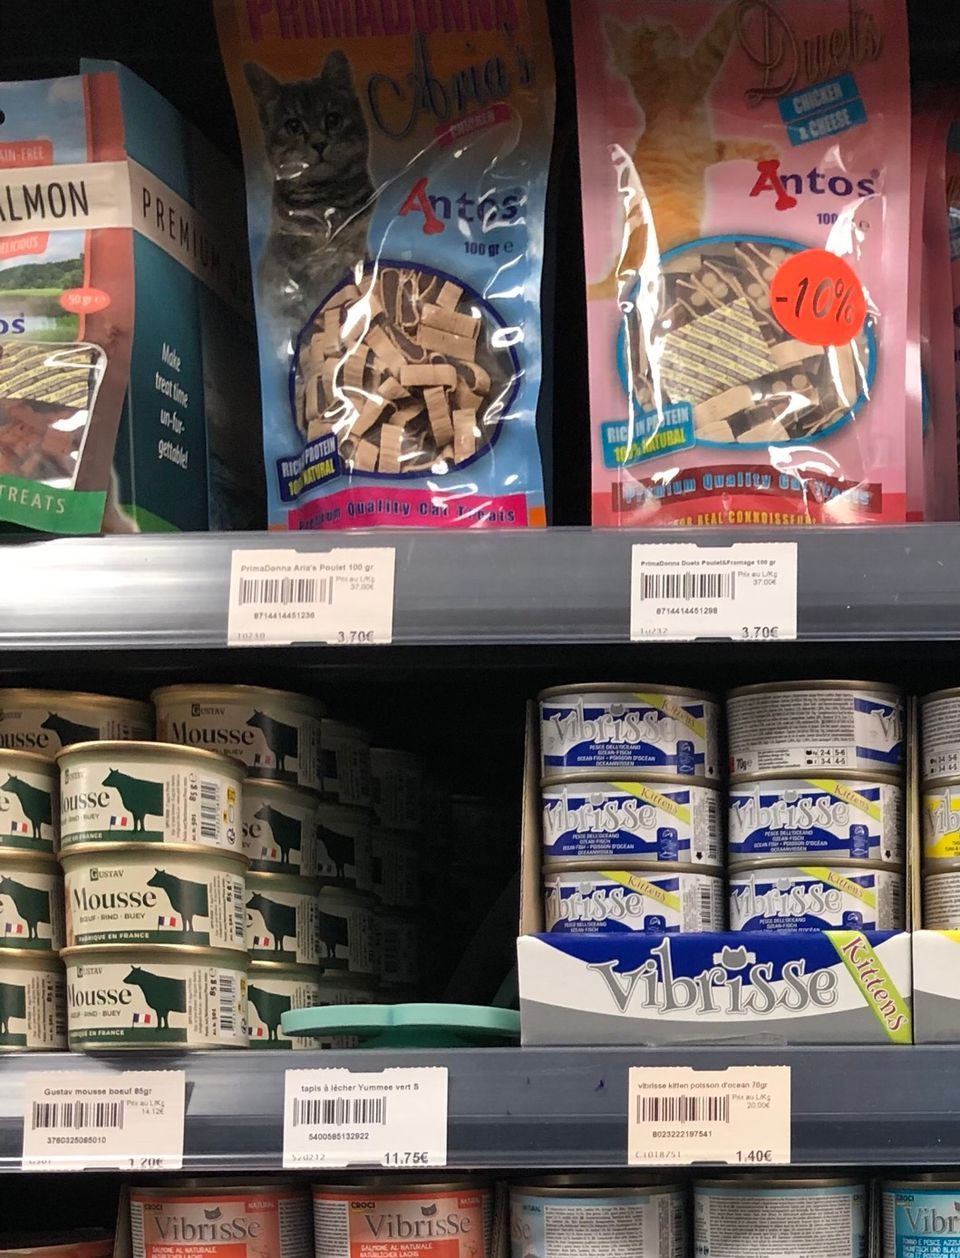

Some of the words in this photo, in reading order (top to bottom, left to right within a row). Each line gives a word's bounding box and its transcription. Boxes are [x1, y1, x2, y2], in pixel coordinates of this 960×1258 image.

[749, 159, 876, 211] Antos
[401, 177, 520, 235] Antos
[776, 276, 854, 325] -10%
[161, 342, 181, 373] Make
[156, 374, 172, 398] treat
[172, 384, 188, 409] time
[158, 439, 189, 469] gettable!
[338, 631, 374, 642] 3.70€
[742, 627, 779, 638] 3.70€
[833, 783, 871, 814] Kittens
[90, 868, 124, 881] GUSTAV
[74, 887, 157, 912] Mousse
[841, 935, 908, 1033] Kittens
[384, 1152, 428, 1164] 11.75€
[736, 1150, 772, 1162] 1.40€
